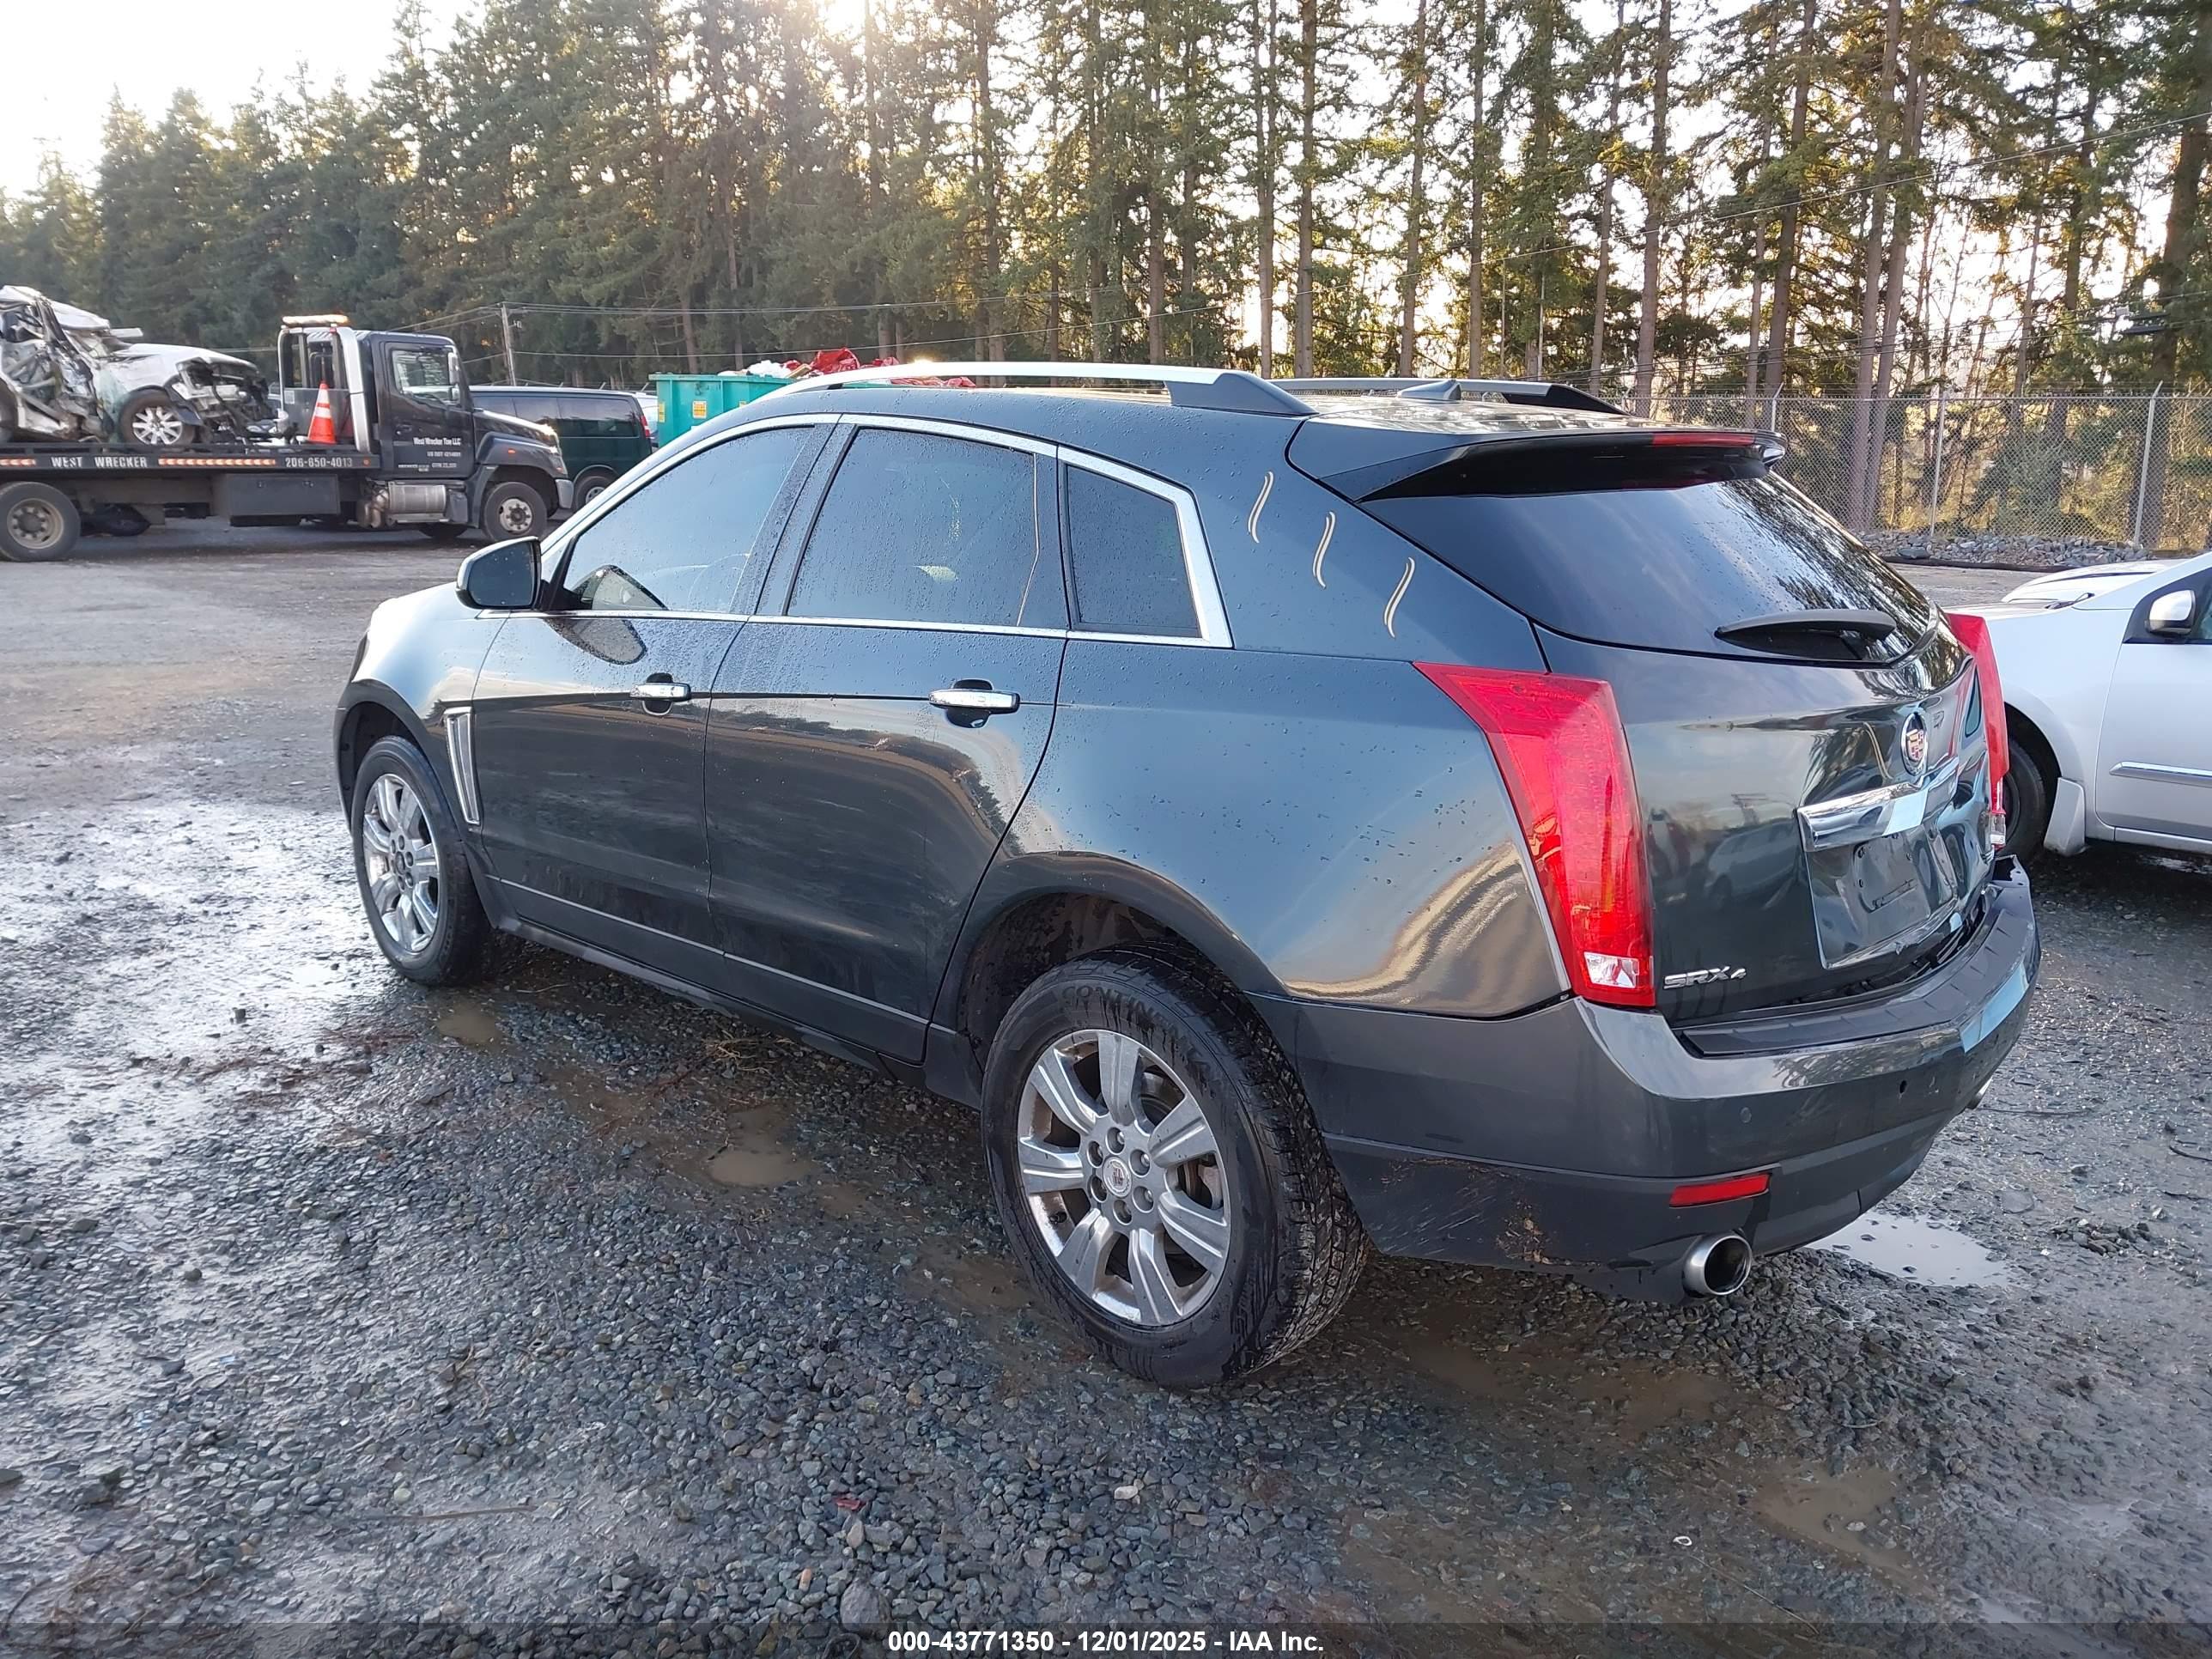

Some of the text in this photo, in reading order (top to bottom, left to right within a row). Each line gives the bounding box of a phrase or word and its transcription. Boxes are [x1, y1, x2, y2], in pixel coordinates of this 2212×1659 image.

[453, 437, 461, 446] LLC
[51, 456, 148, 468] WEST WRECKER
